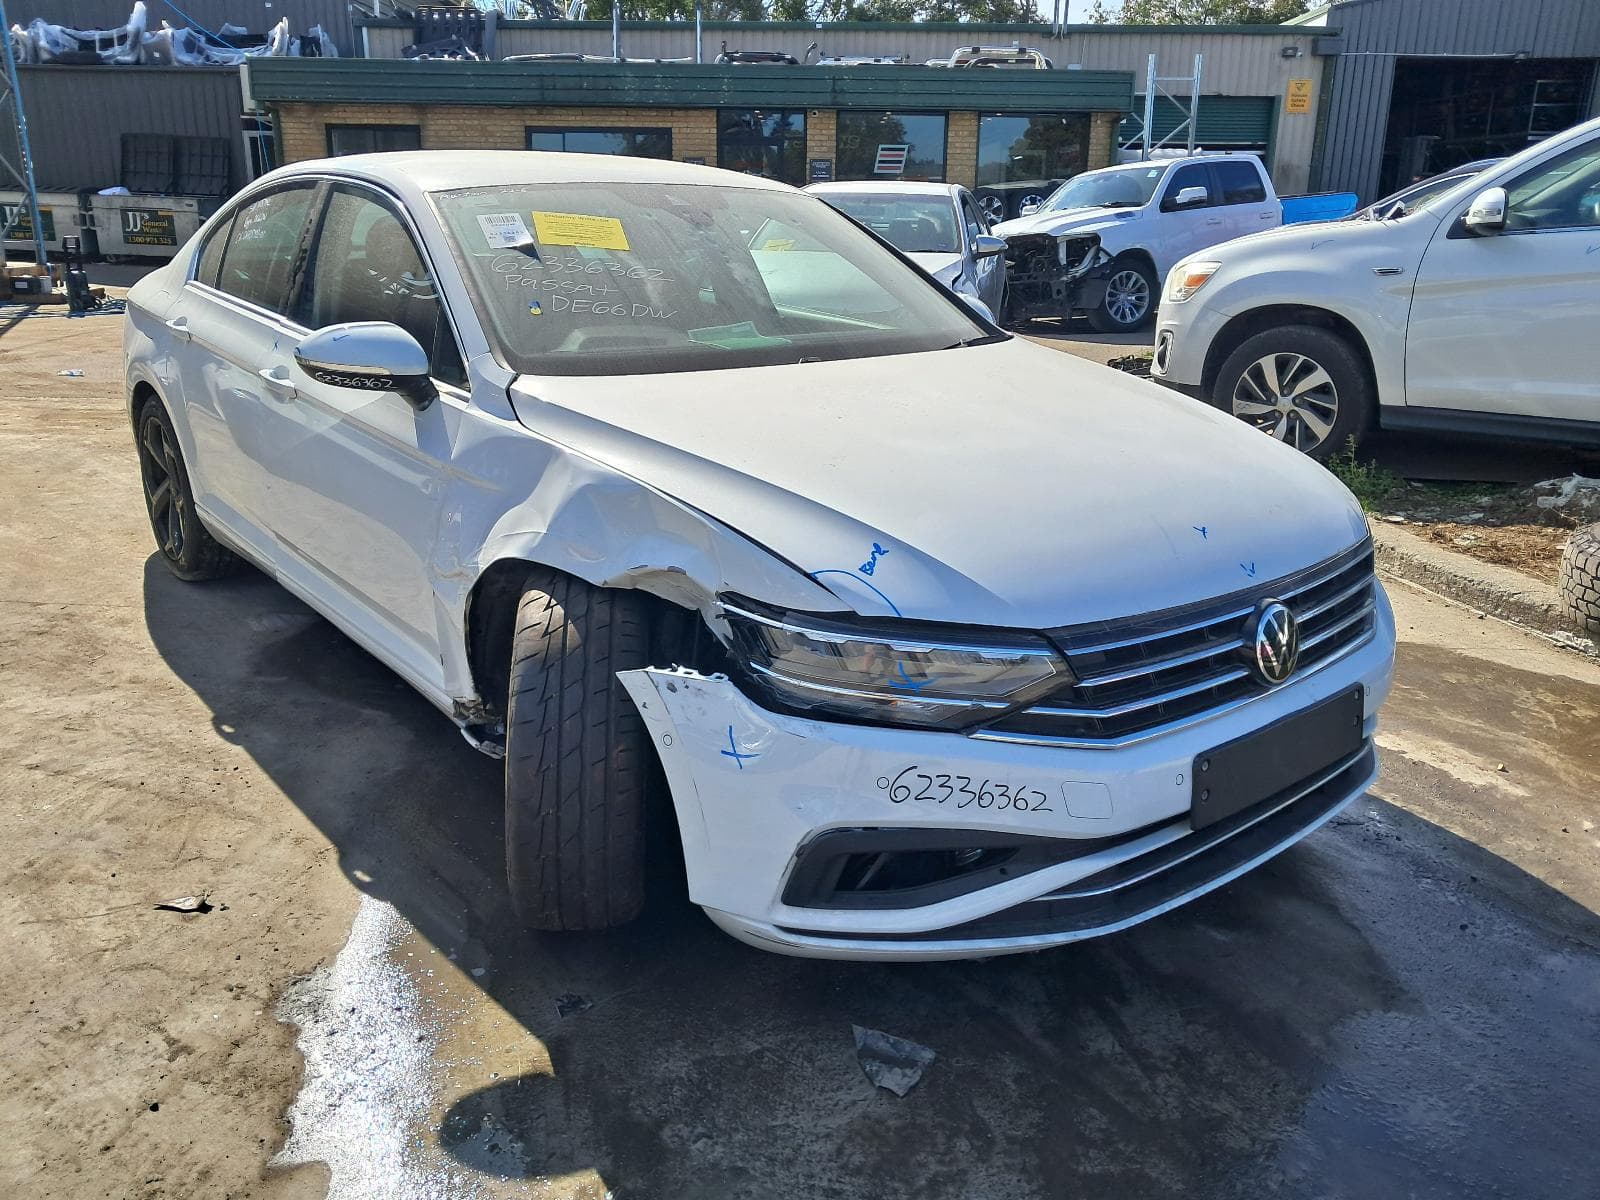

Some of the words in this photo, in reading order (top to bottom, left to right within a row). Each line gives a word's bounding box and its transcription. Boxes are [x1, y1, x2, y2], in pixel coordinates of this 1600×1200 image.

[142, 219, 168, 227] General
[491, 255, 675, 282] 62336362
[504, 274, 619, 296] Passat
[315, 371, 400, 389] 62336362
[889, 765, 1053, 811] 62336362
